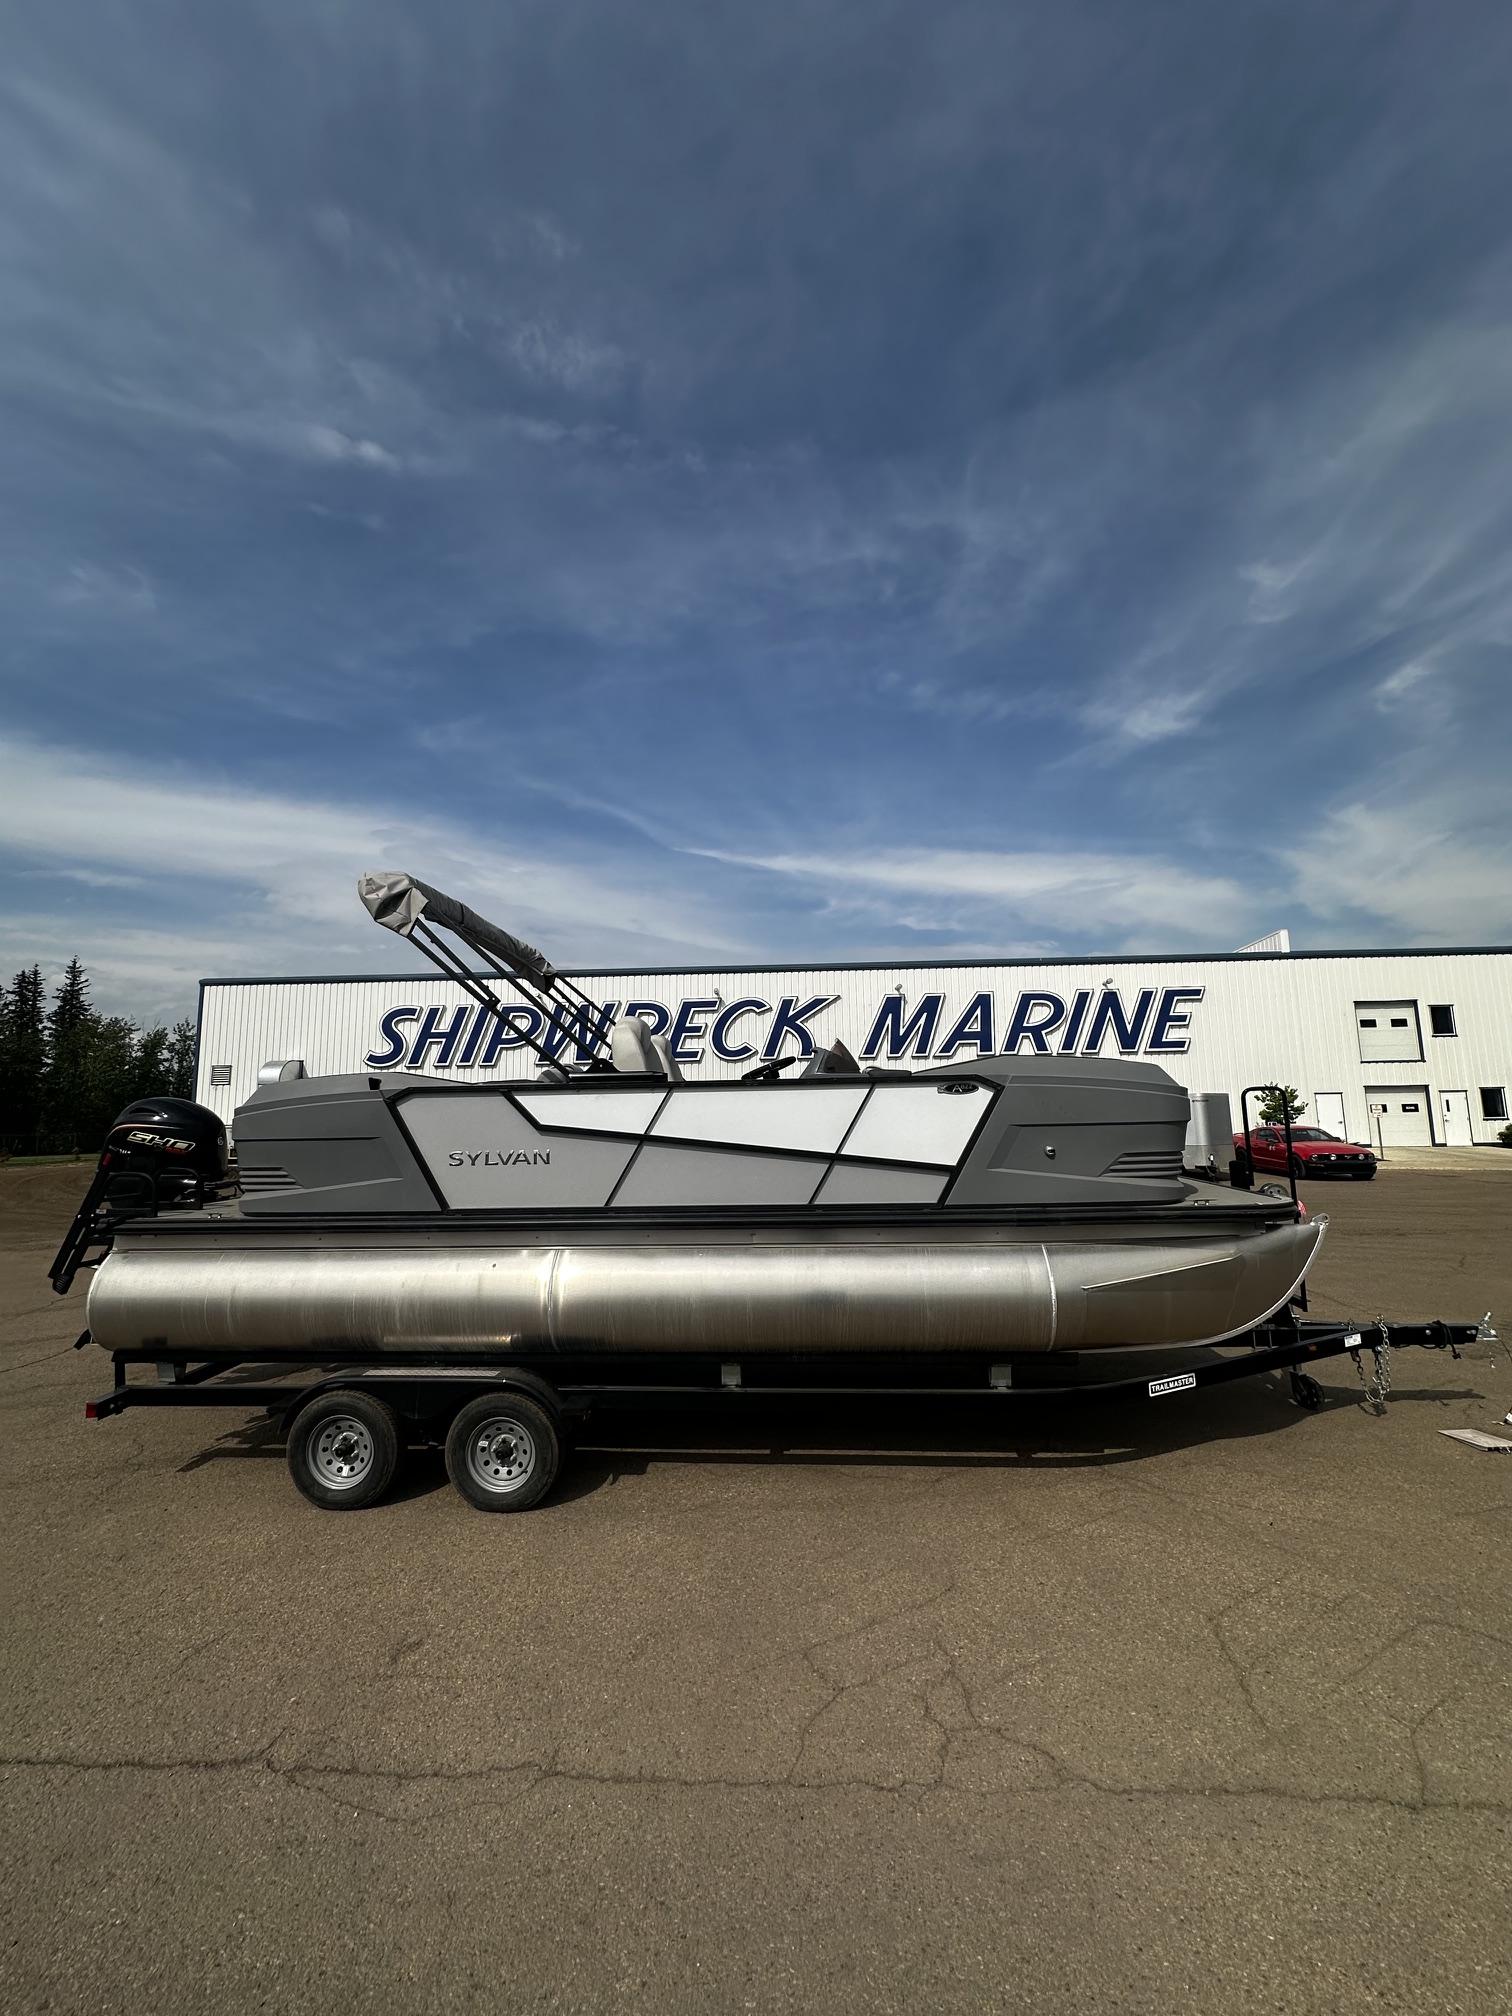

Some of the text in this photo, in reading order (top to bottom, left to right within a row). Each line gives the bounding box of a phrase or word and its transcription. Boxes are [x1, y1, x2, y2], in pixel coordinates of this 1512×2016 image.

[859, 986, 1205, 1060] MARINE
[449, 1149, 551, 1166] SYLVAN
[1151, 1377, 1194, 1392] TRAILMASTER
